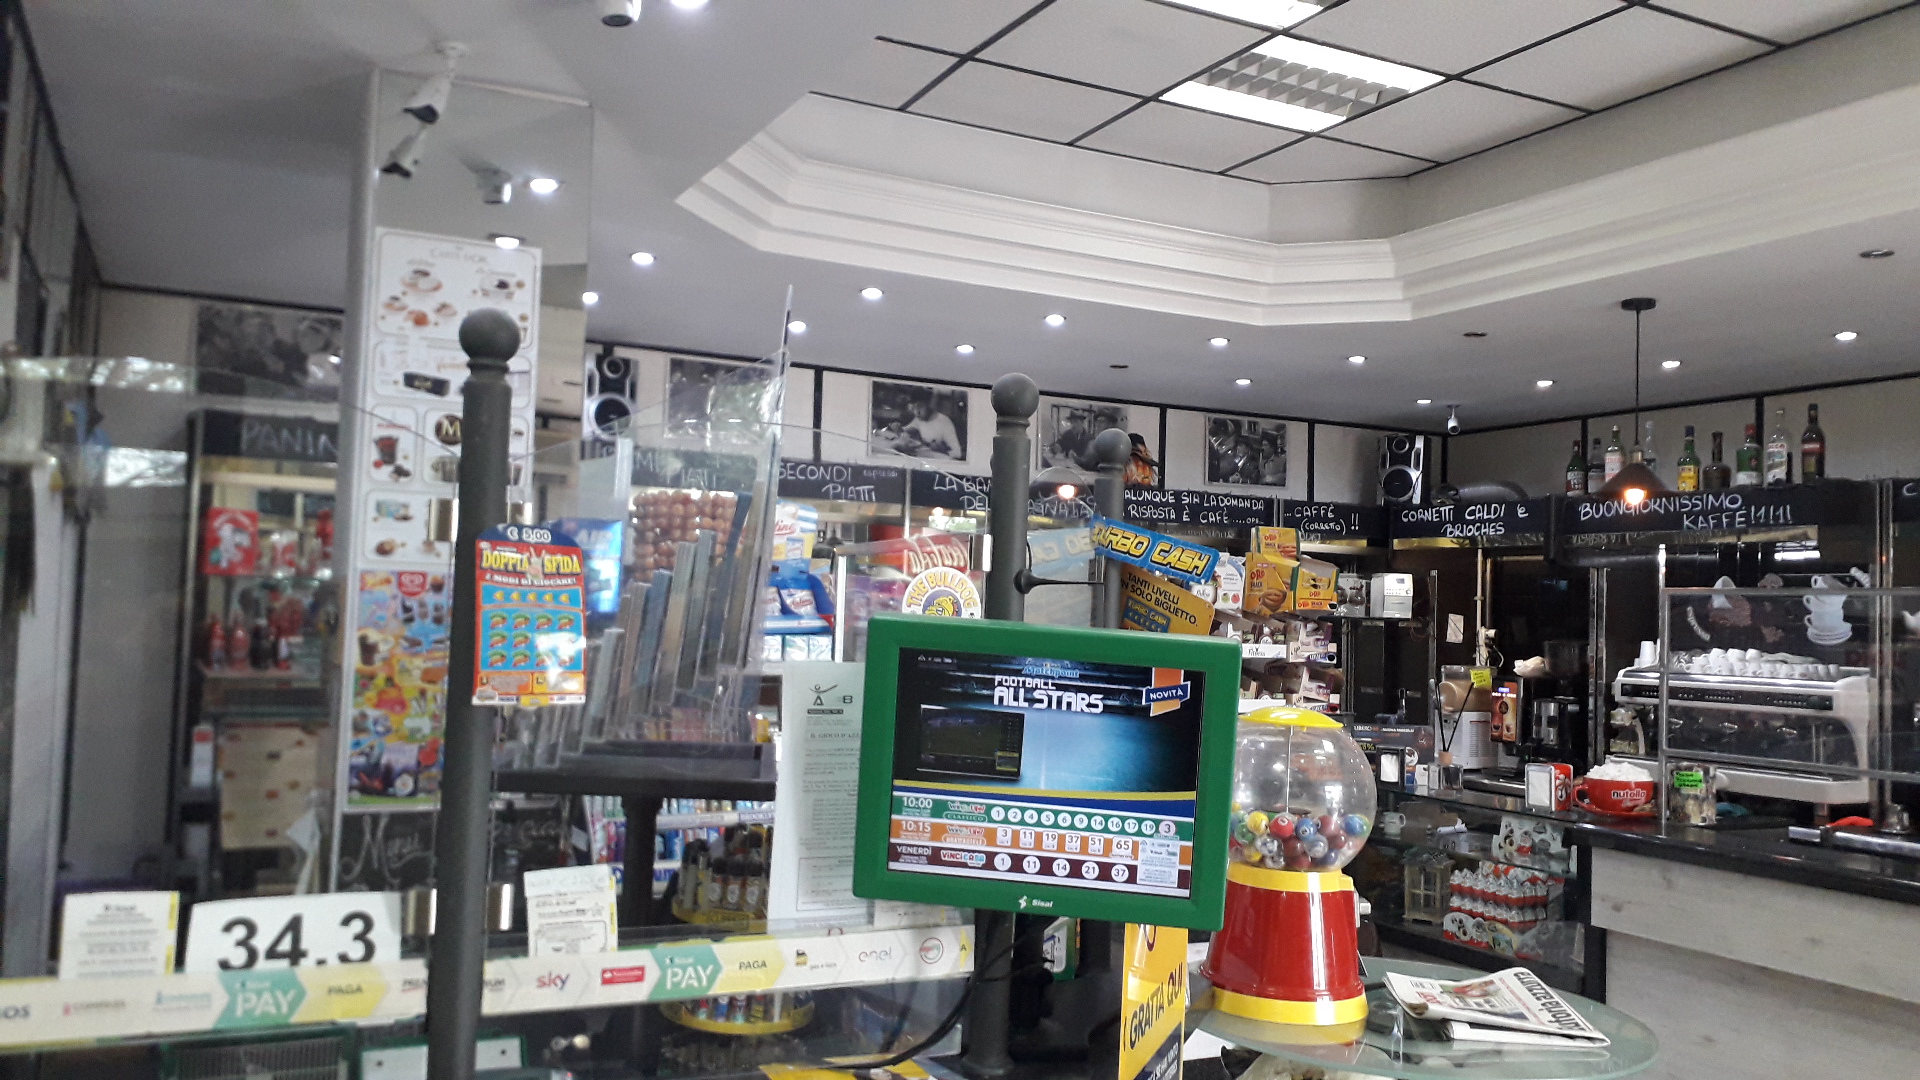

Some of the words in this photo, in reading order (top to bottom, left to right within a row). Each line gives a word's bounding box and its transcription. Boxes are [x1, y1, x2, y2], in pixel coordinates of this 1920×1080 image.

[241, 420, 338, 457] PANIN
[778, 461, 852, 481] SECONDI
[821, 482, 876, 502] PIATTI
[933, 474, 957, 492] LA
[1124, 490, 1178, 504] ALUNQUE
[1181, 491, 1200, 504] SIA
[1127, 505, 1176, 521] RISPOSTA
[1401, 505, 1454, 522] CORNETTI
[1465, 503, 1506, 520] CALDI
[1441, 521, 1505, 538] BRIOCHES
[482, 549, 529, 572] DOPPIA
[544, 553, 582, 575] SFIDA
[1151, 541, 1211, 577] CASH
[906, 580, 928, 608] THE
[925, 571, 979, 608] BULLDOG
[1128, 572, 1151, 591] TANTI
[1151, 583, 1180, 605] LIVELLI
[1130, 581, 1153, 602] SOLO
[1154, 596, 1198, 627] BIGLIETTO.
[994, 675, 1056, 690] FOOTBALL
[993, 686, 1029, 708] ALL
[1032, 691, 1104, 714] STARS
[1149, 687, 1184, 701] NOVITÀ
[902, 797, 933, 809] 10:00
[901, 820, 931, 832] 10:15
[1094, 818, 1104, 828] 14
[1110, 820, 1120, 828] 16
[1126, 822, 1136, 830] 17
[1144, 824, 1154, 832] 19
[1022, 830, 1032, 840] 11
[1044, 832, 1056, 842] 19
[1068, 834, 1080, 844] 37
[1090, 836, 1102, 846] 51
[1116, 838, 1130, 850] 65
[896, 845, 932, 856] VENERDÌ
[1026, 860, 1038, 870] 11
[1056, 862, 1068, 872] 14
[1084, 866, 1096, 874] 21
[1114, 868, 1126, 878] 37
[1032, 898, 1054, 908] Sisal
[218, 911, 376, 970] 34.3
[858, 947, 893, 963] enel
[536, 970, 570, 991] sky
[666, 964, 714, 990] PAY
[738, 959, 768, 971] PAGA
[235, 988, 296, 1017] PAY
[327, 984, 363, 996] PAGA
[1129, 982, 1165, 1050] GRATTA
